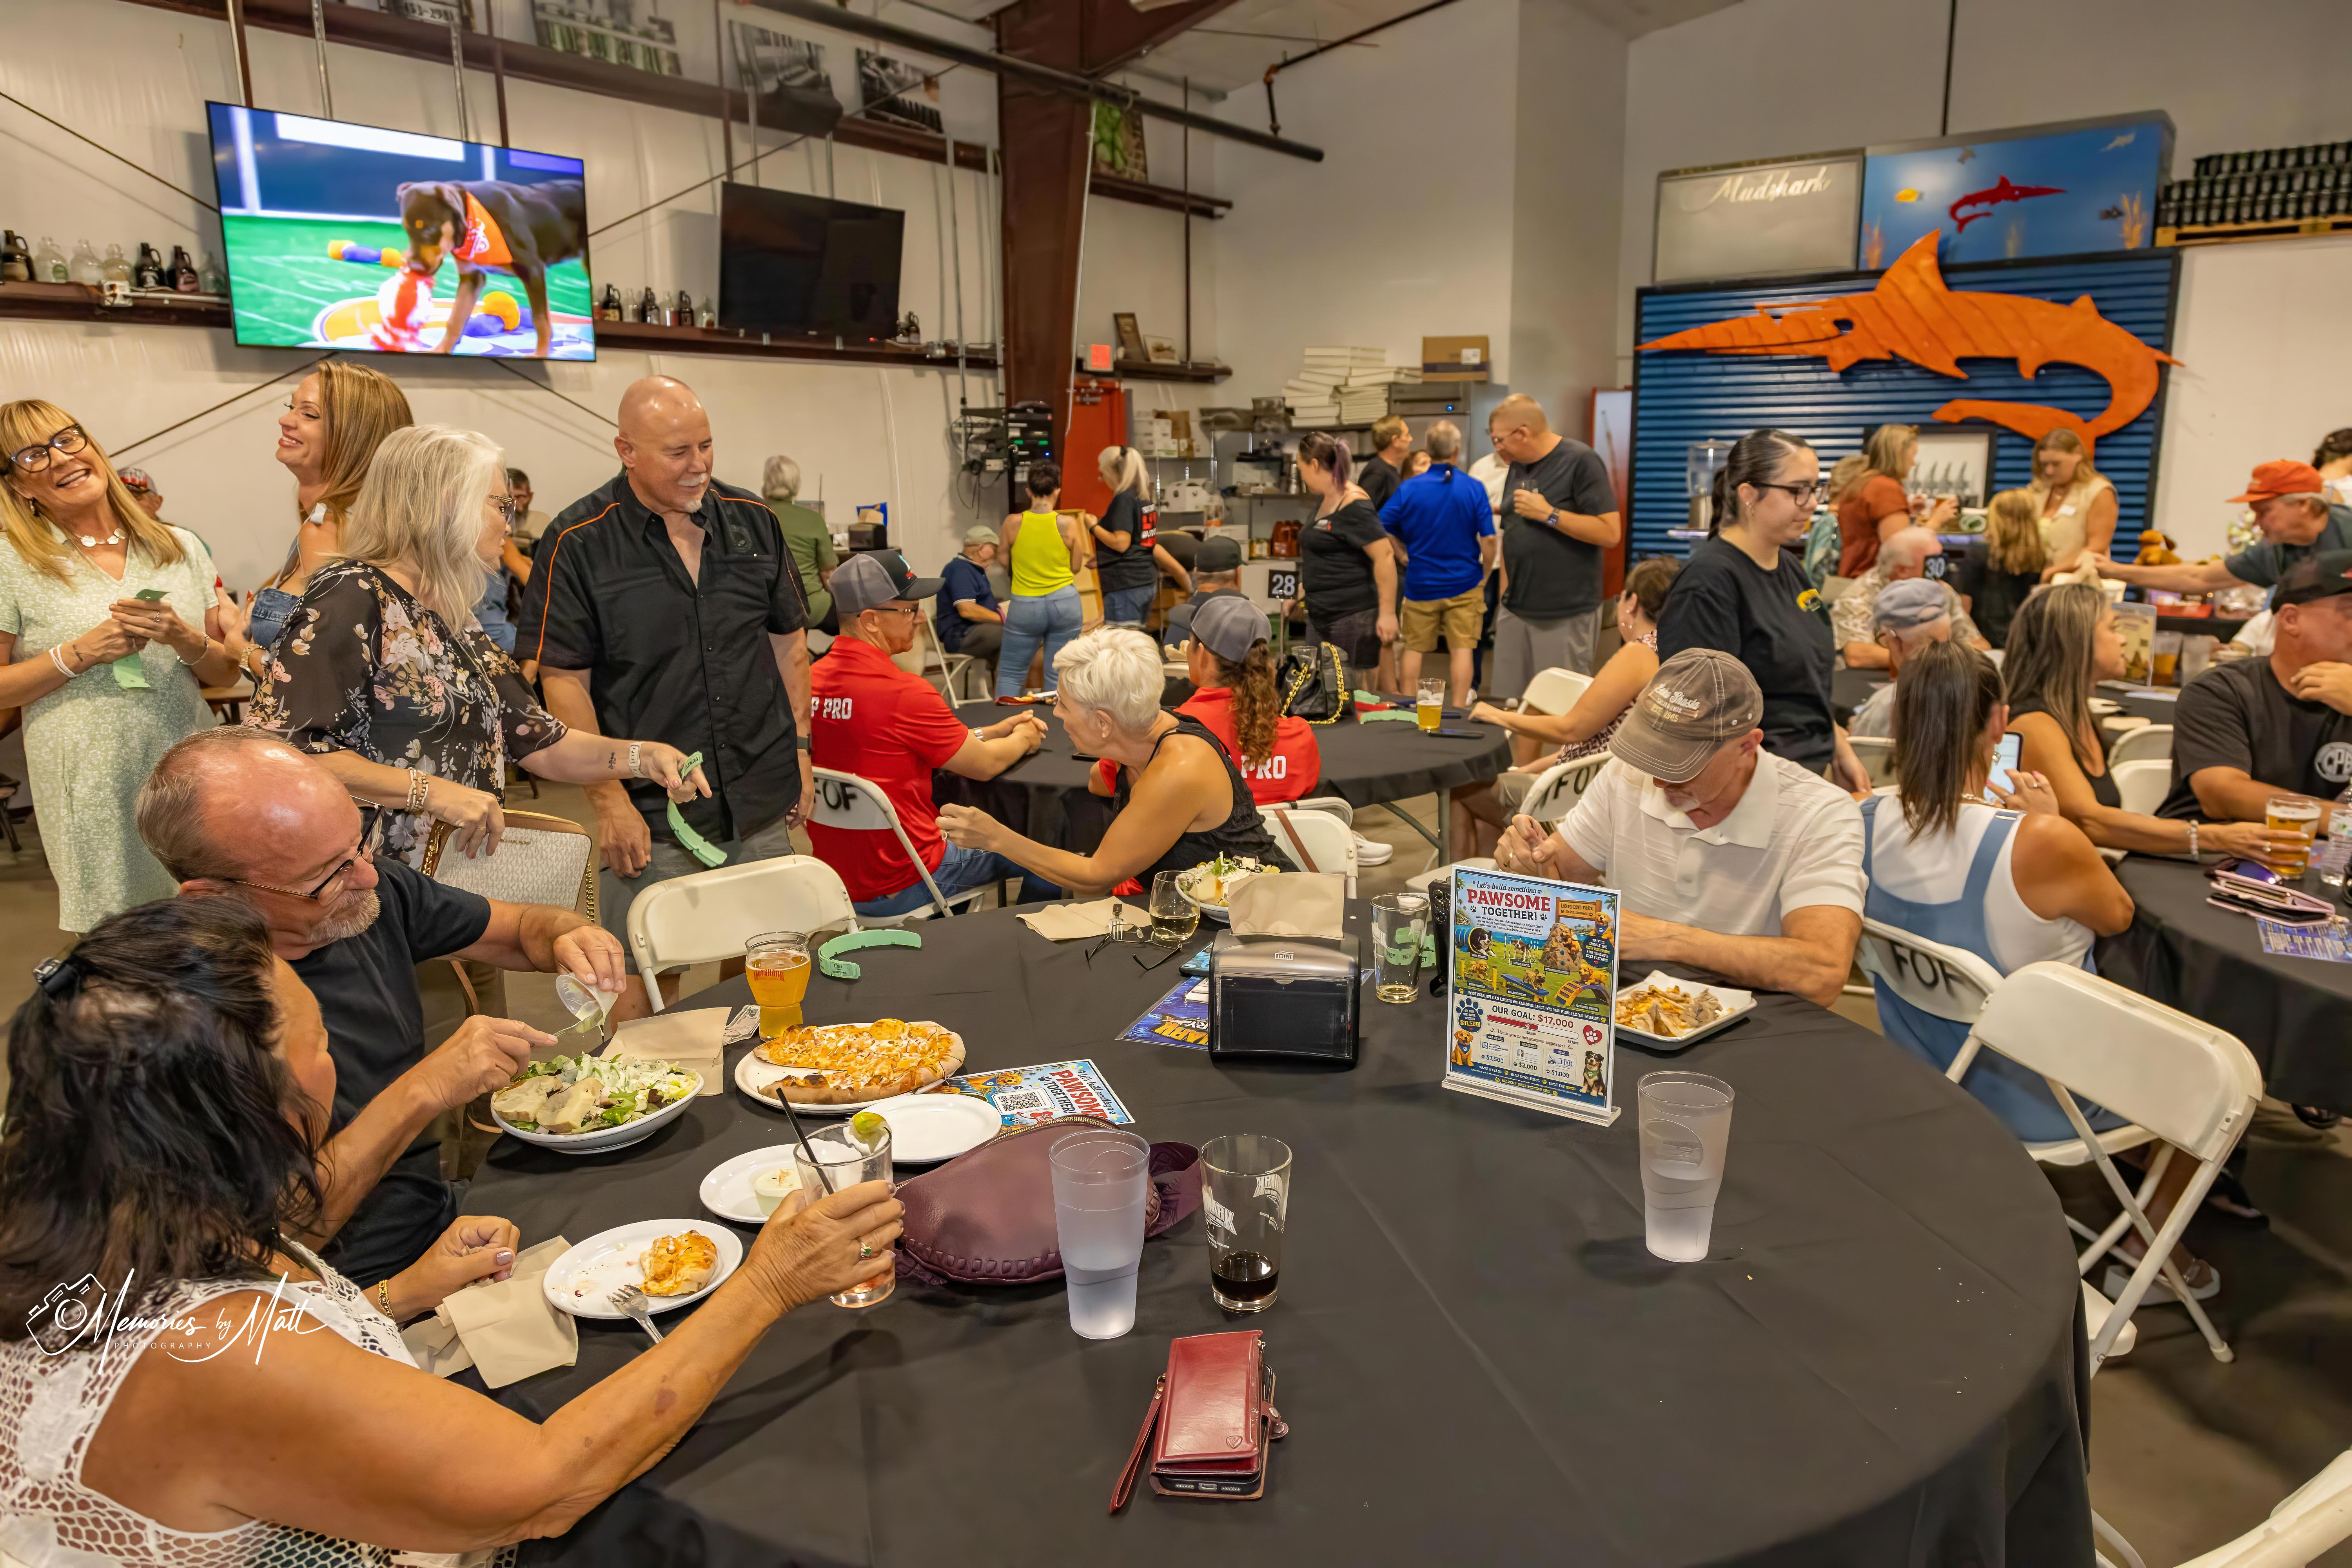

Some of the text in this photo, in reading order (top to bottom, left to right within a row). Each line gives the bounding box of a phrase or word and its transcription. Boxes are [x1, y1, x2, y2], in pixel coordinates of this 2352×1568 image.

[1705, 165, 1833, 204] Mudshark
[1925, 558, 1945, 579] 30
[1272, 574, 1295, 595] 28
[823, 698, 853, 719] PRO
[1670, 691, 1700, 710] Shasta
[1241, 755, 1286, 779] PRO
[1553, 764, 1600, 799] FO
[1477, 881, 1490, 889] Let's
[1508, 886, 1537, 895] something
[1467, 889, 1550, 912] PAWSOME
[1481, 906, 1537, 921] TOGETHER!
[1492, 1005, 1508, 1015] OUR
[1511, 1009, 1535, 1020] GOAL:
[1538, 1014, 1573, 1028] $17,000
[1044, 1081, 1077, 1114] TOGETHER!
